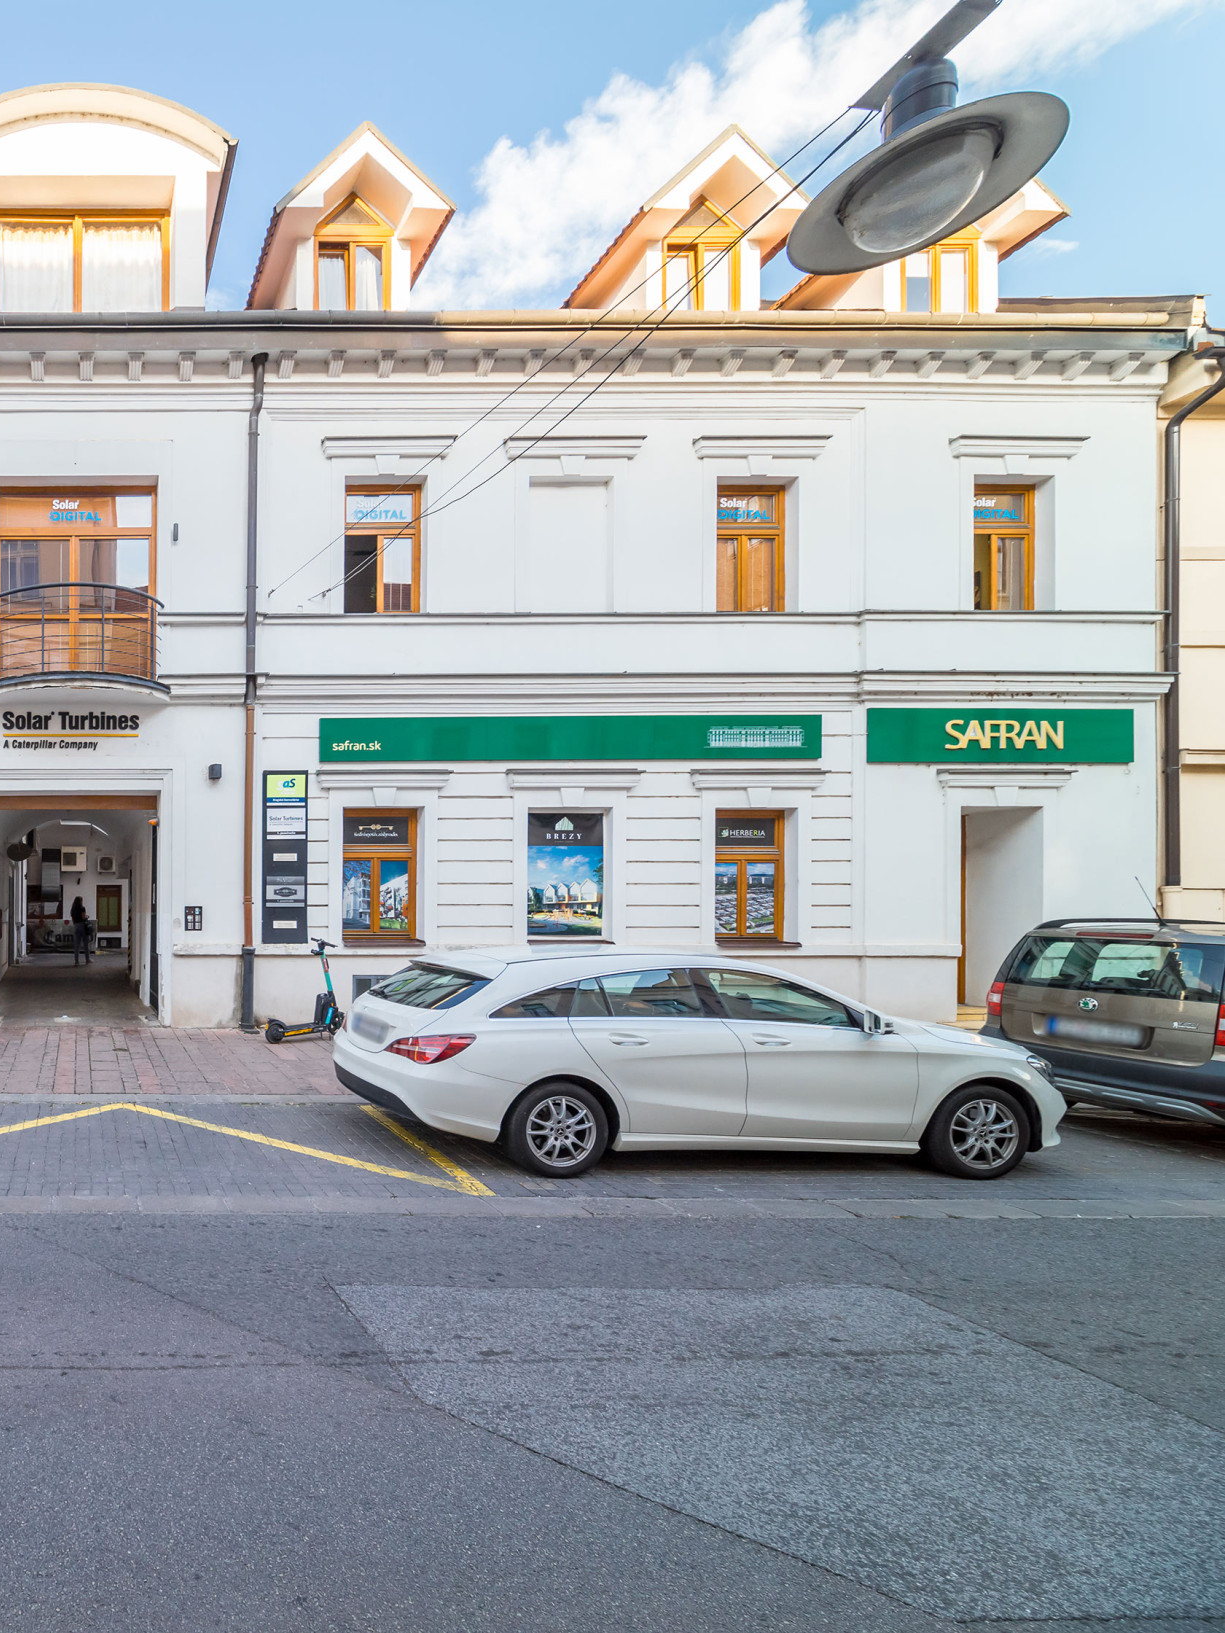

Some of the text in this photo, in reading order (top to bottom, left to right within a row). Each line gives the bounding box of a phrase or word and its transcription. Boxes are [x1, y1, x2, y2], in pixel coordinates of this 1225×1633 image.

[52, 499, 79, 510] Solar
[719, 497, 747, 508] Solar
[49, 511, 102, 522] DIGITAL
[353, 509, 407, 520] DIGITAL
[717, 509, 771, 520] DIGITAL
[2, 711, 140, 730] Solar Turbines
[944, 719, 1065, 751] SAFRAN
[3, 740, 98, 751] A Caterpillar Company
[332, 740, 382, 751] safran.sk
